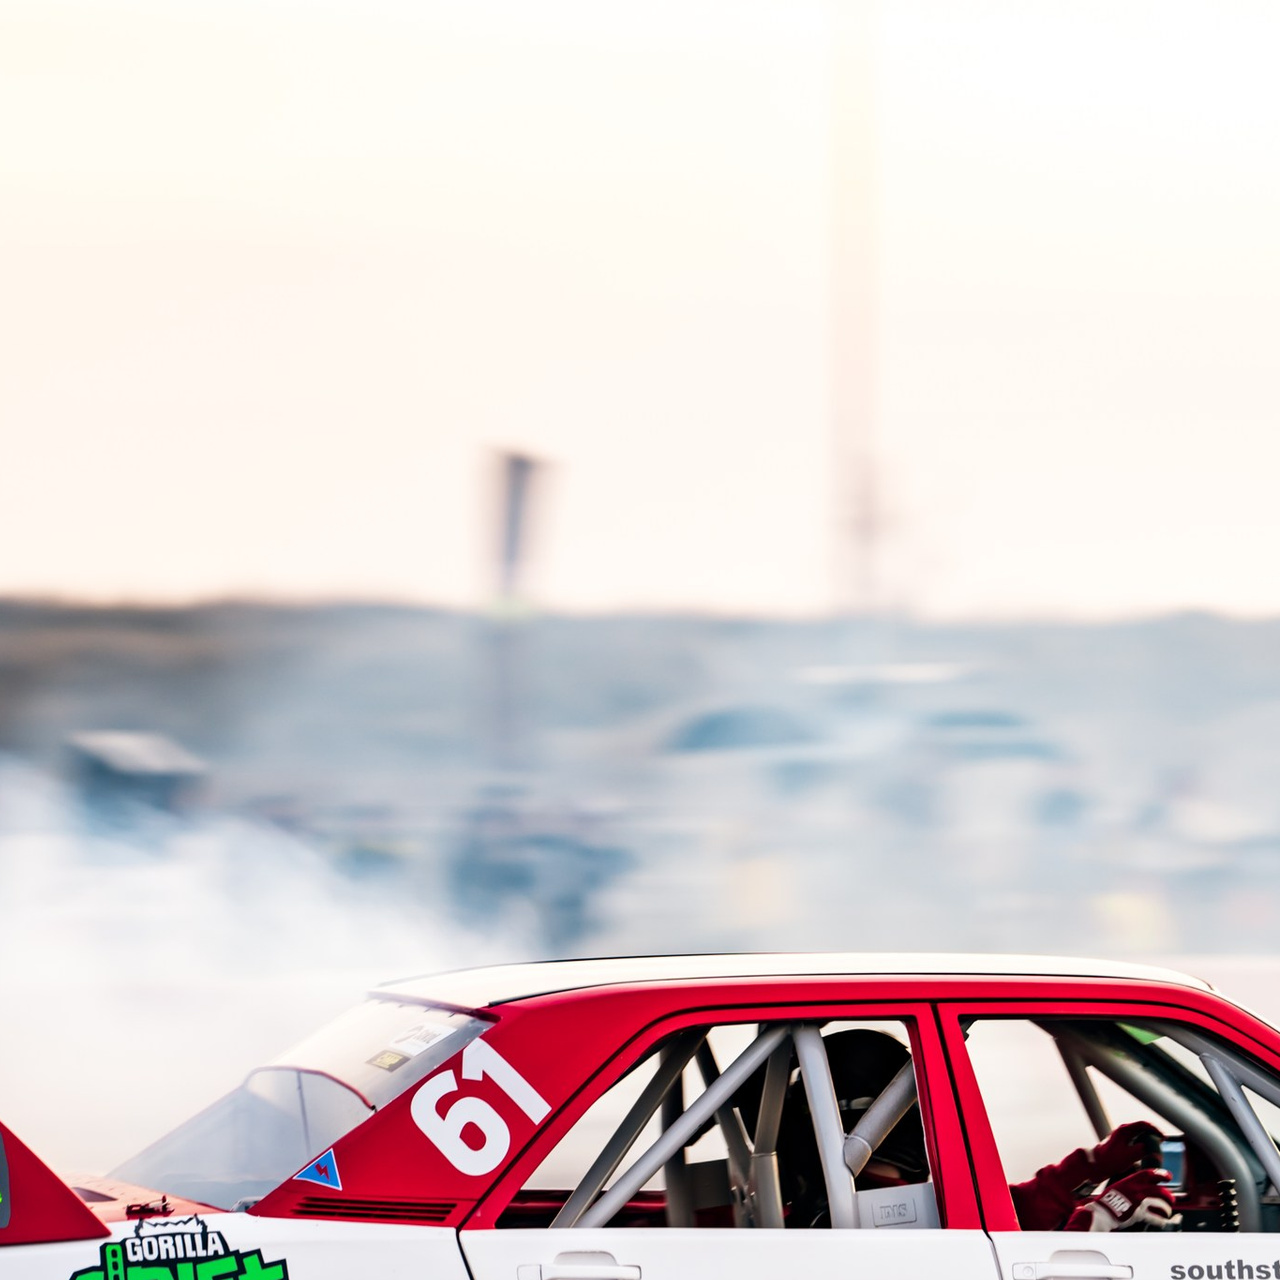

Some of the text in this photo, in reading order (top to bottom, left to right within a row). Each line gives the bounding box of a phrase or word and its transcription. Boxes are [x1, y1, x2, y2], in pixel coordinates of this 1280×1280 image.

[410, 1036, 552, 1177] 61
[1103, 1190, 1131, 1212] OMP
[125, 1231, 225, 1262] GORILLA
